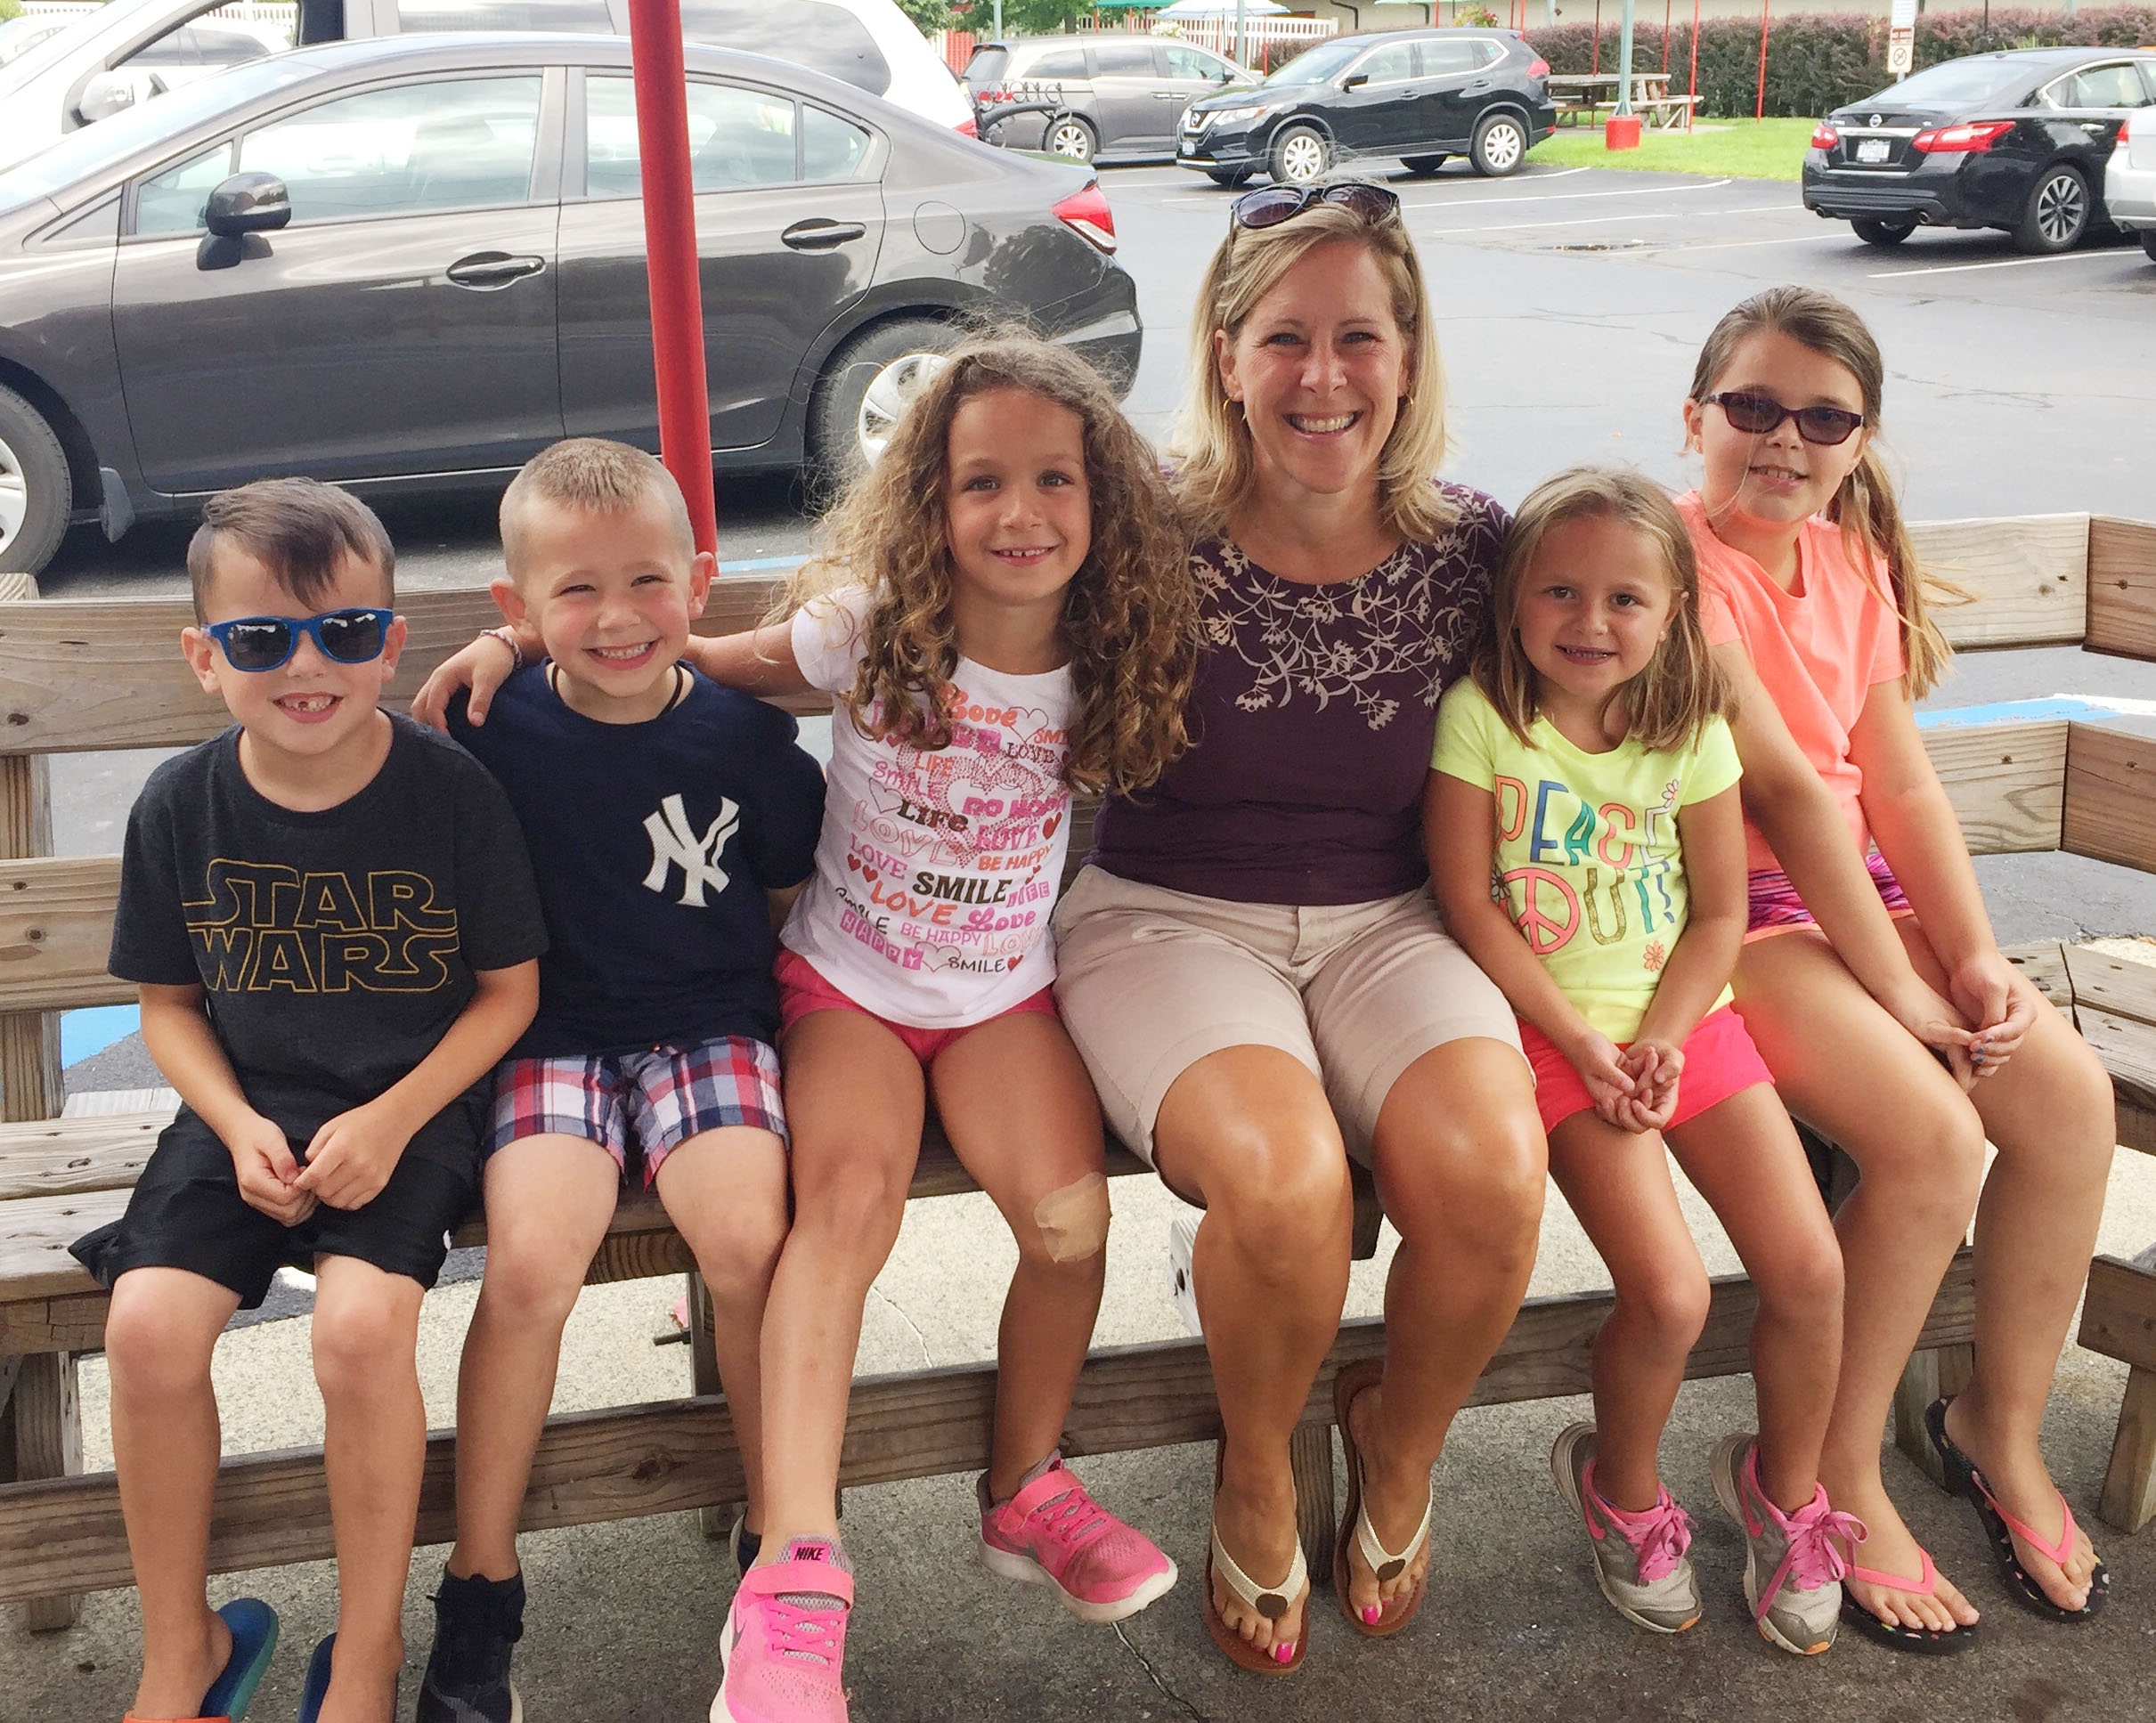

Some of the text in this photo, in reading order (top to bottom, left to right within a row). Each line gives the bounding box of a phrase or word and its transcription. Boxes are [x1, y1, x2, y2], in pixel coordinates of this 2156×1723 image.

[1494, 774, 1672, 870] PEACE
[850, 833, 908, 880] LOVE
[978, 844, 1054, 871] BE HAPPY
[182, 857, 458, 933] STAR
[870, 880, 958, 925] LOVE
[912, 871, 1013, 905] SMILE
[900, 922, 981, 946] BE HAPPY
[960, 906, 1037, 931] Love
[187, 927, 460, 994] WARS
[948, 956, 1006, 973] SMILE
[793, 1547, 825, 1561] NIKE
